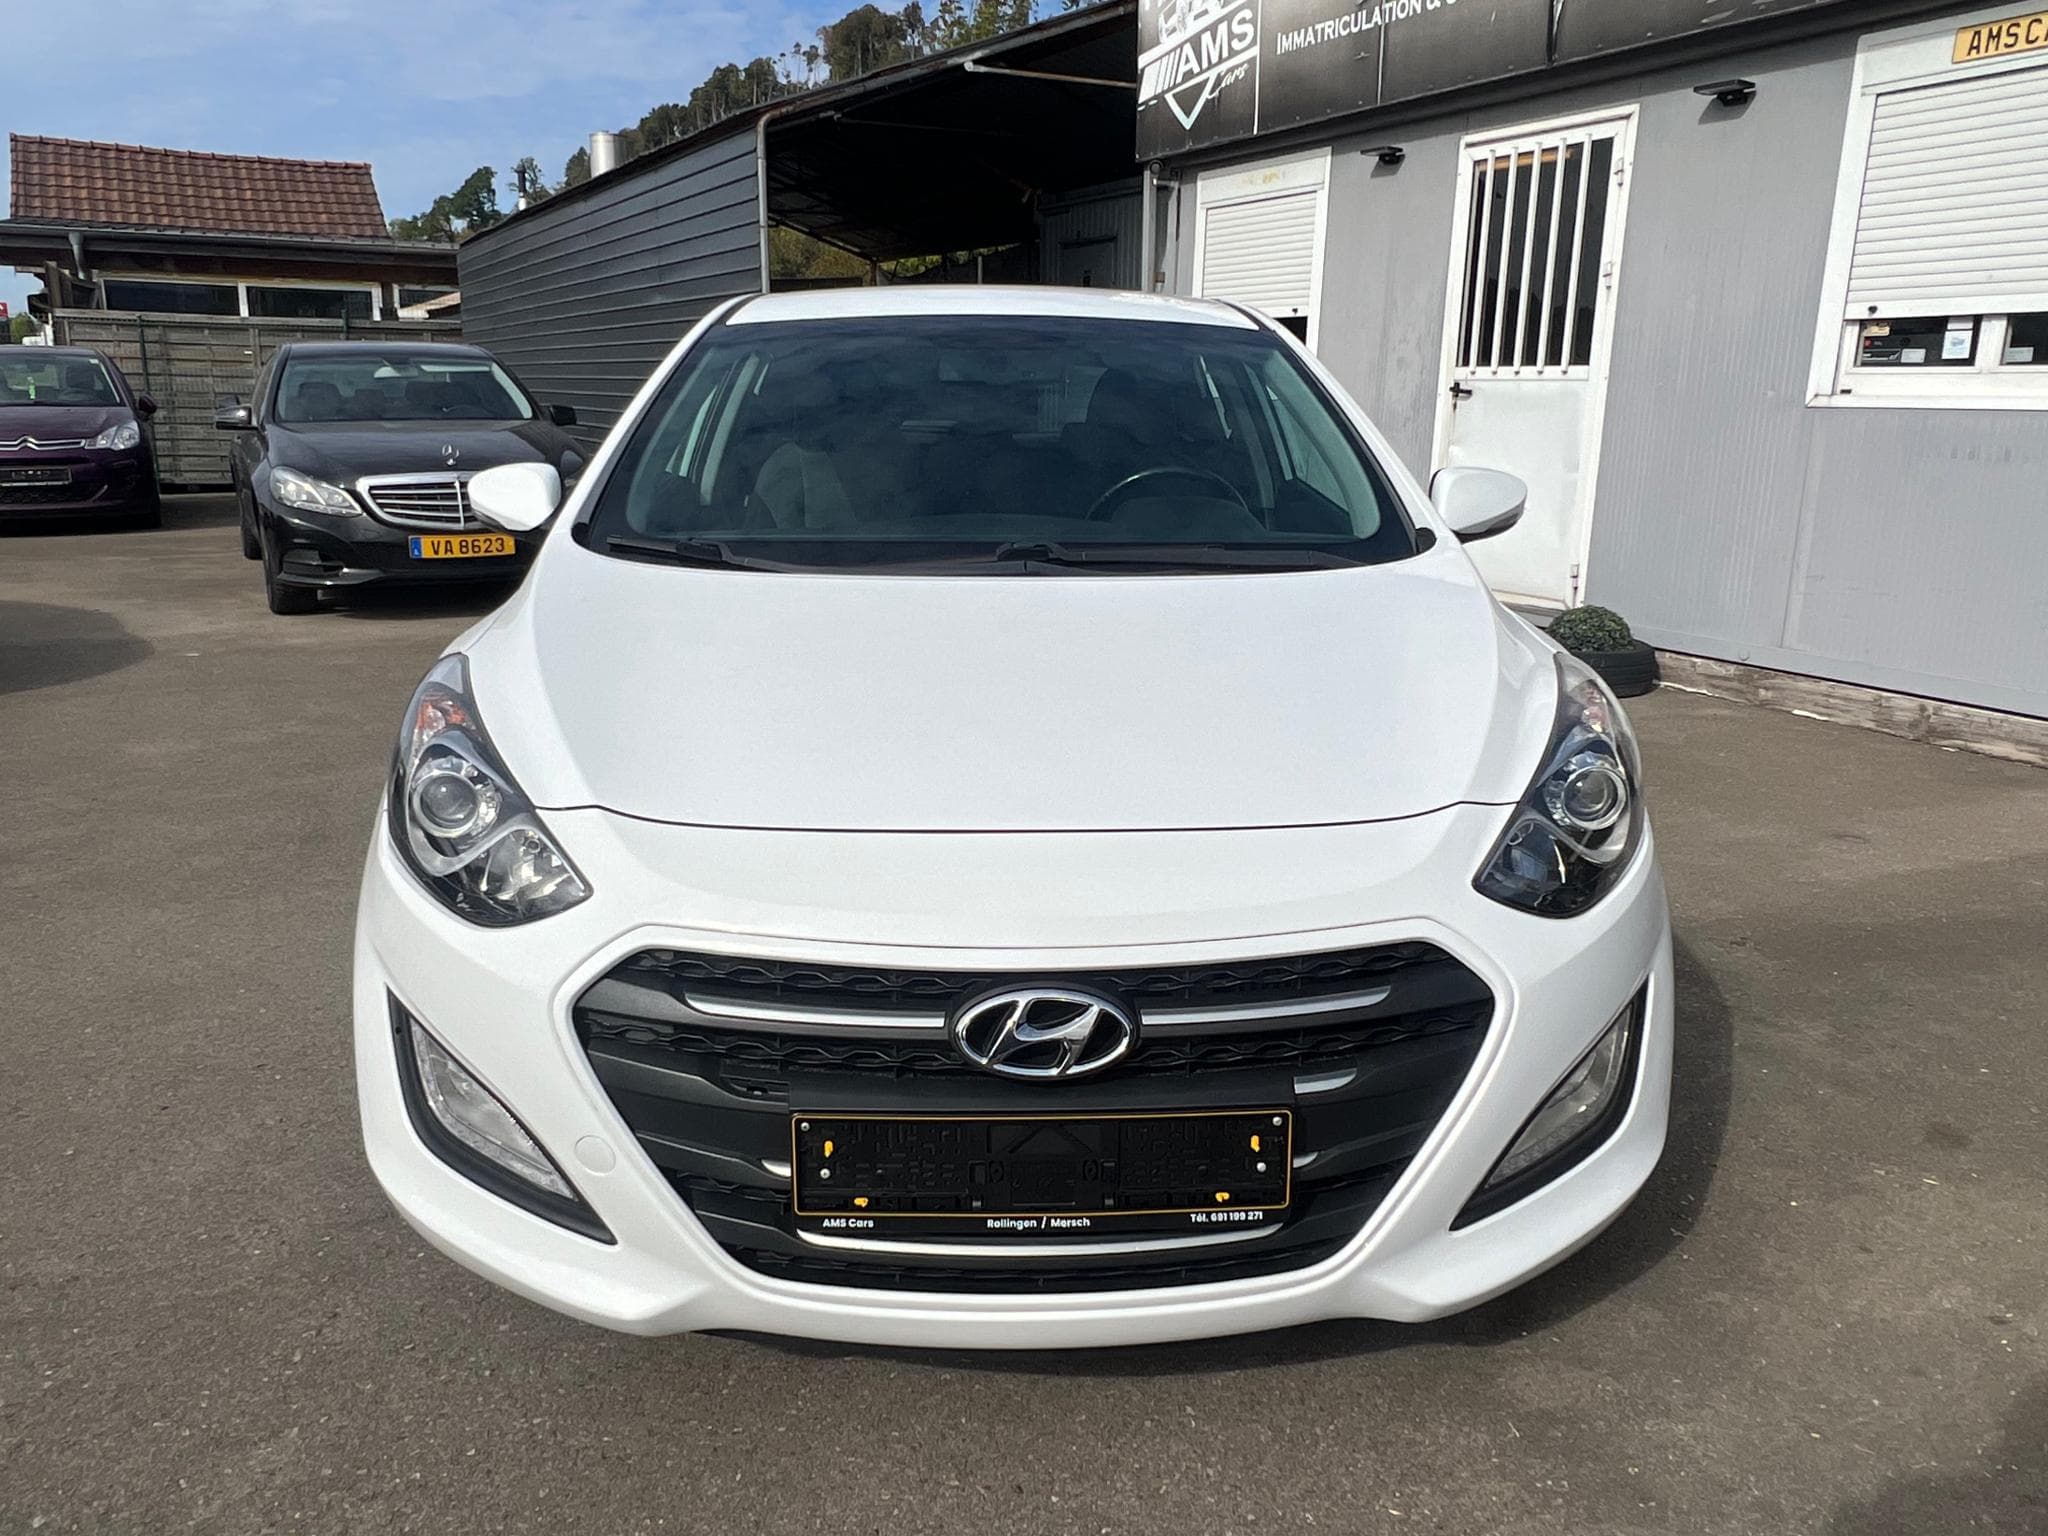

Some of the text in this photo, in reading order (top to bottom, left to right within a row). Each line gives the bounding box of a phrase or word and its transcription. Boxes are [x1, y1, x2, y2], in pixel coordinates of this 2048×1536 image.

[1966, 17, 2048, 56] AMSC
[1175, 8, 1255, 87] AMS
[431, 537, 505, 555] VA 8623
[822, 1218, 874, 1228] AMS Cars
[1247, 1211, 1263, 1220] 271
[986, 1218, 1037, 1231] Rollingen
[1050, 1217, 1091, 1228] Mersch
